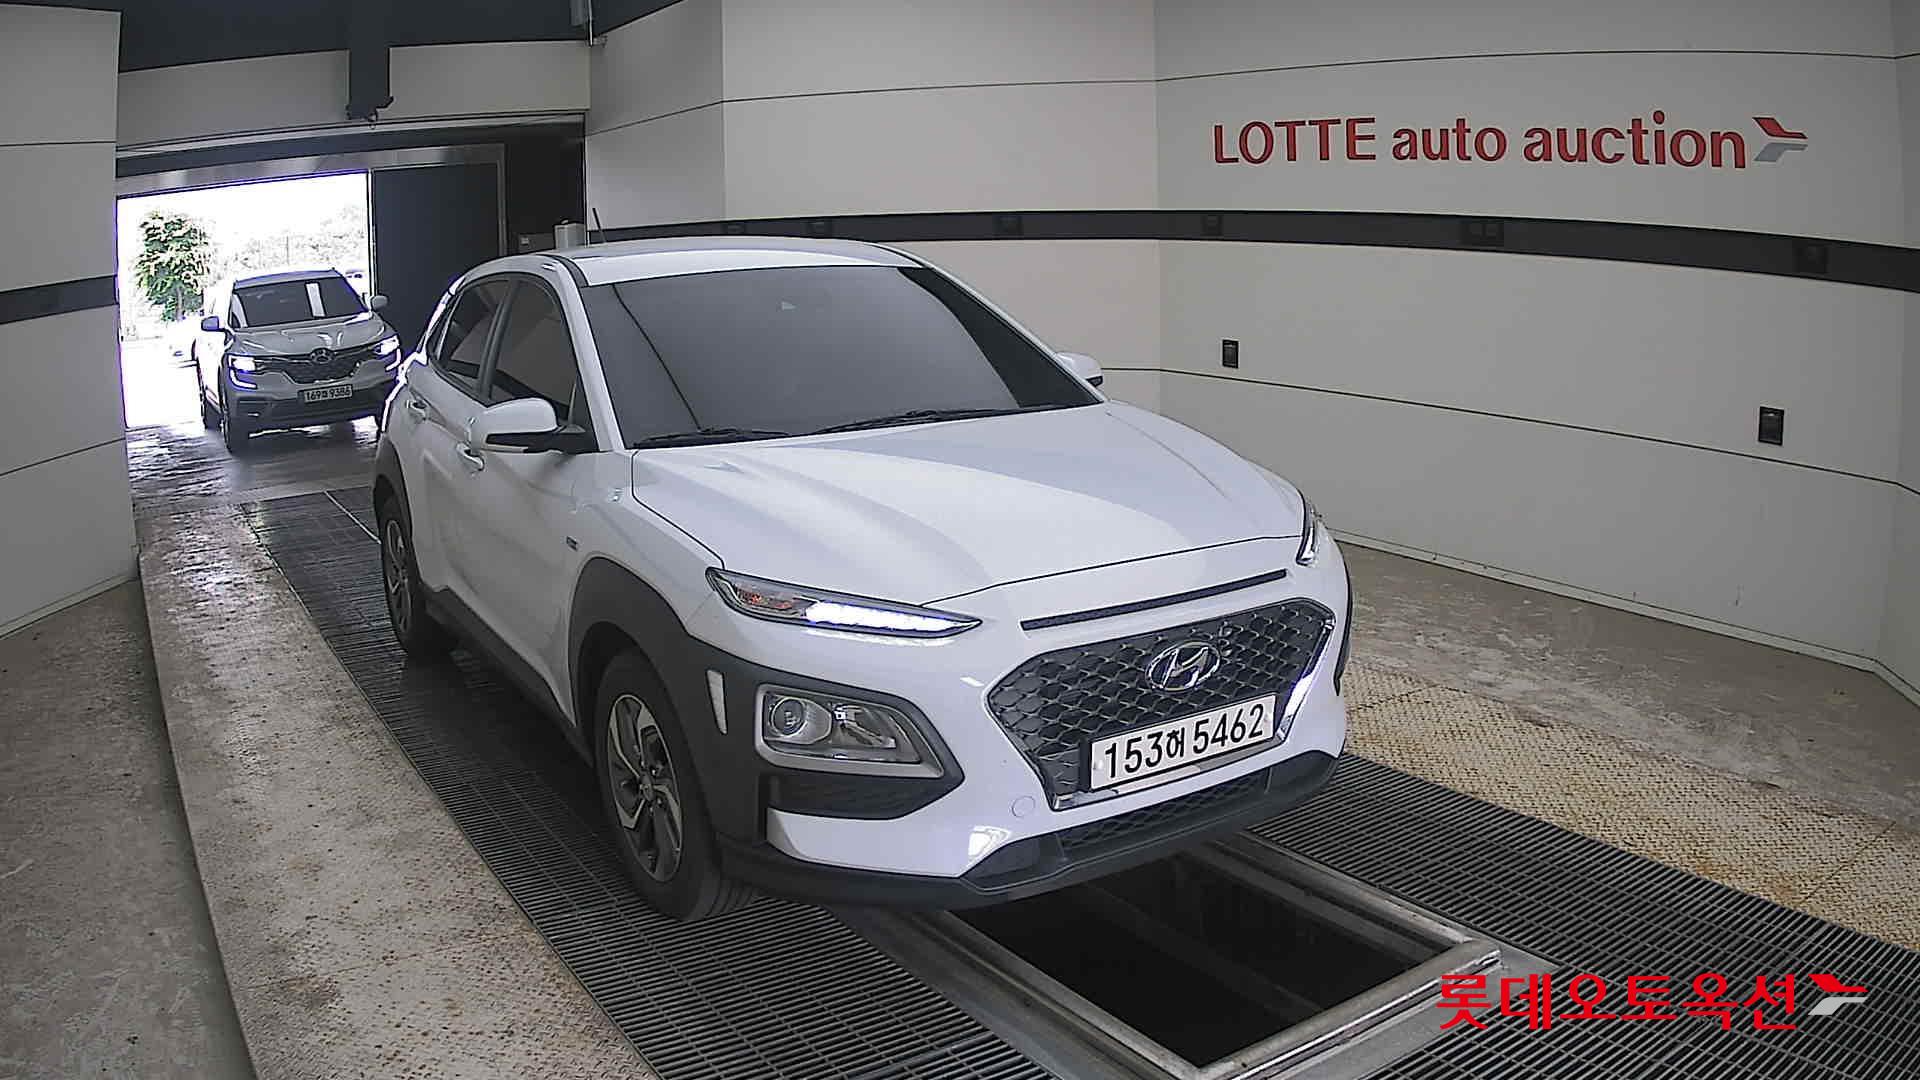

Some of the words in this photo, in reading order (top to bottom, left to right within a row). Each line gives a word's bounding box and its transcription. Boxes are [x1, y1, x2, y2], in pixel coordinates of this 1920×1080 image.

[1213, 116, 1377, 164] LOTTE
[1391, 117, 1508, 162] auto
[1523, 110, 1747, 169] auction
[1104, 726, 1186, 779] 153허
[1192, 703, 1265, 755] 5462
